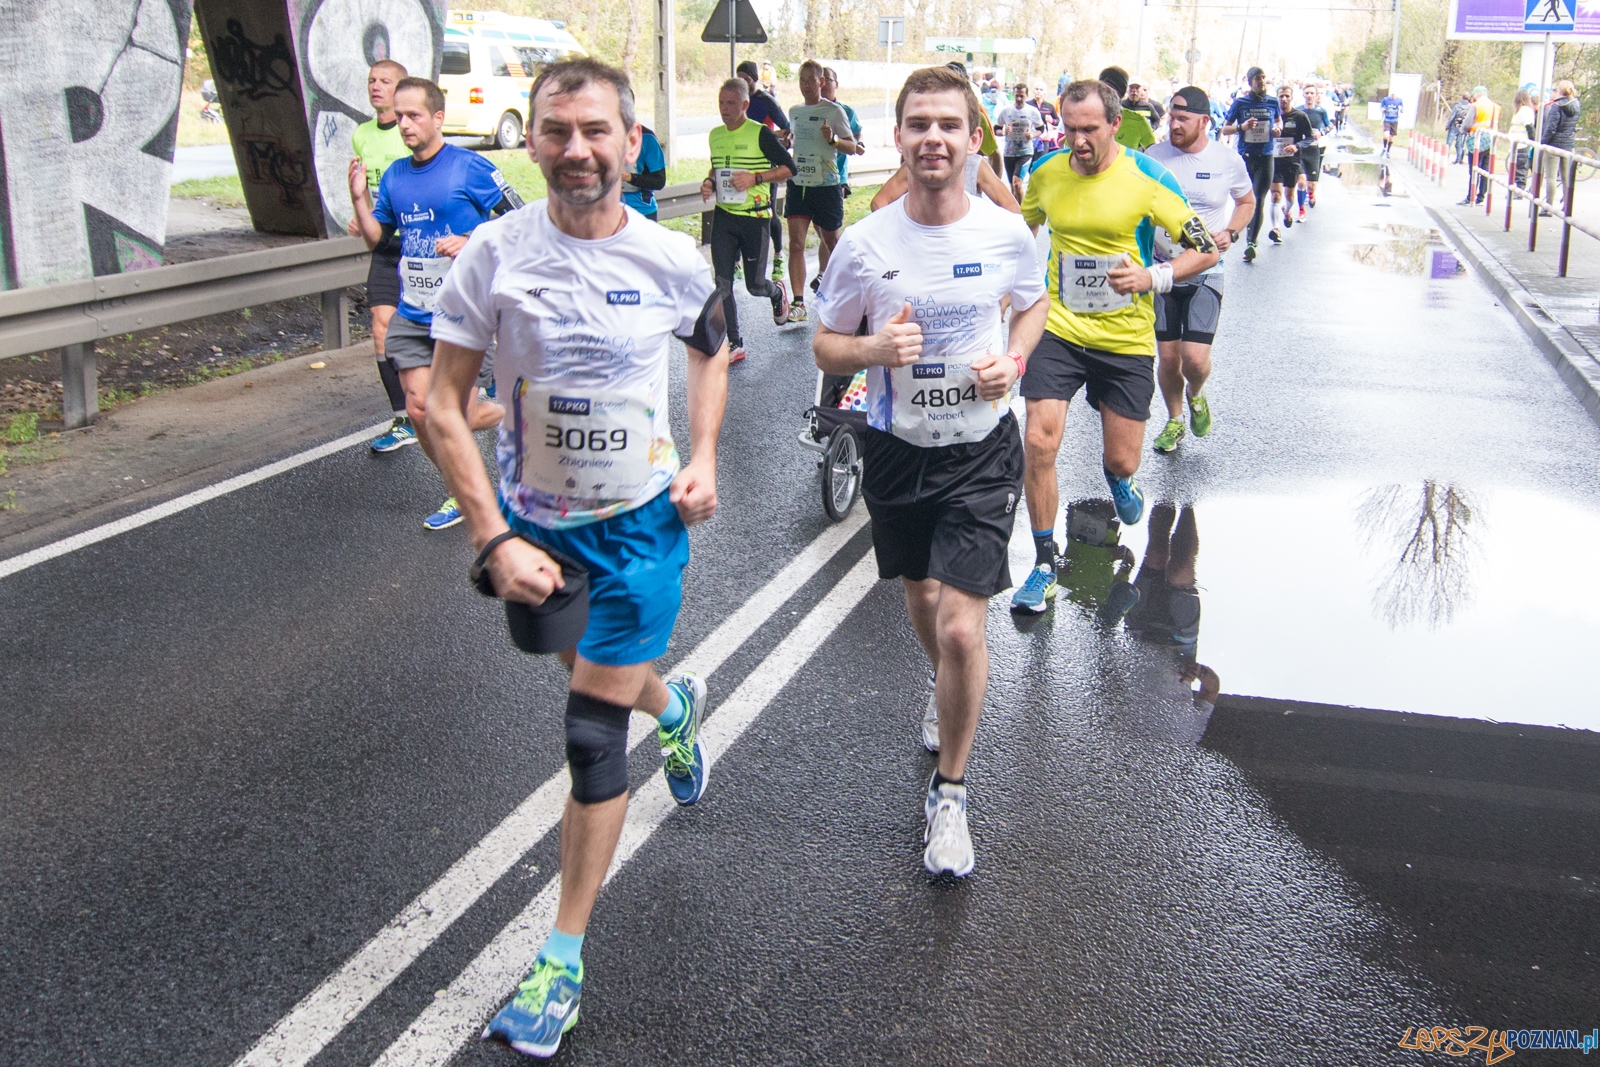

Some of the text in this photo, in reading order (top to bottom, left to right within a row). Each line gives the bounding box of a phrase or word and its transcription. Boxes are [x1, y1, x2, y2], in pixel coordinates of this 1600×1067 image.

[409, 275, 444, 289] 5964
[882, 270, 900, 280] 4F
[1075, 275, 1110, 288] 427
[904, 294, 936, 306] SIŁA
[915, 304, 978, 319] ODWAGA
[909, 314, 977, 330] ZYBKOŚĆ
[911, 384, 978, 408] 4804
[928, 410, 965, 421] Norbert
[545, 424, 628, 452] 3069
[558, 455, 614, 469] Zbigniew
